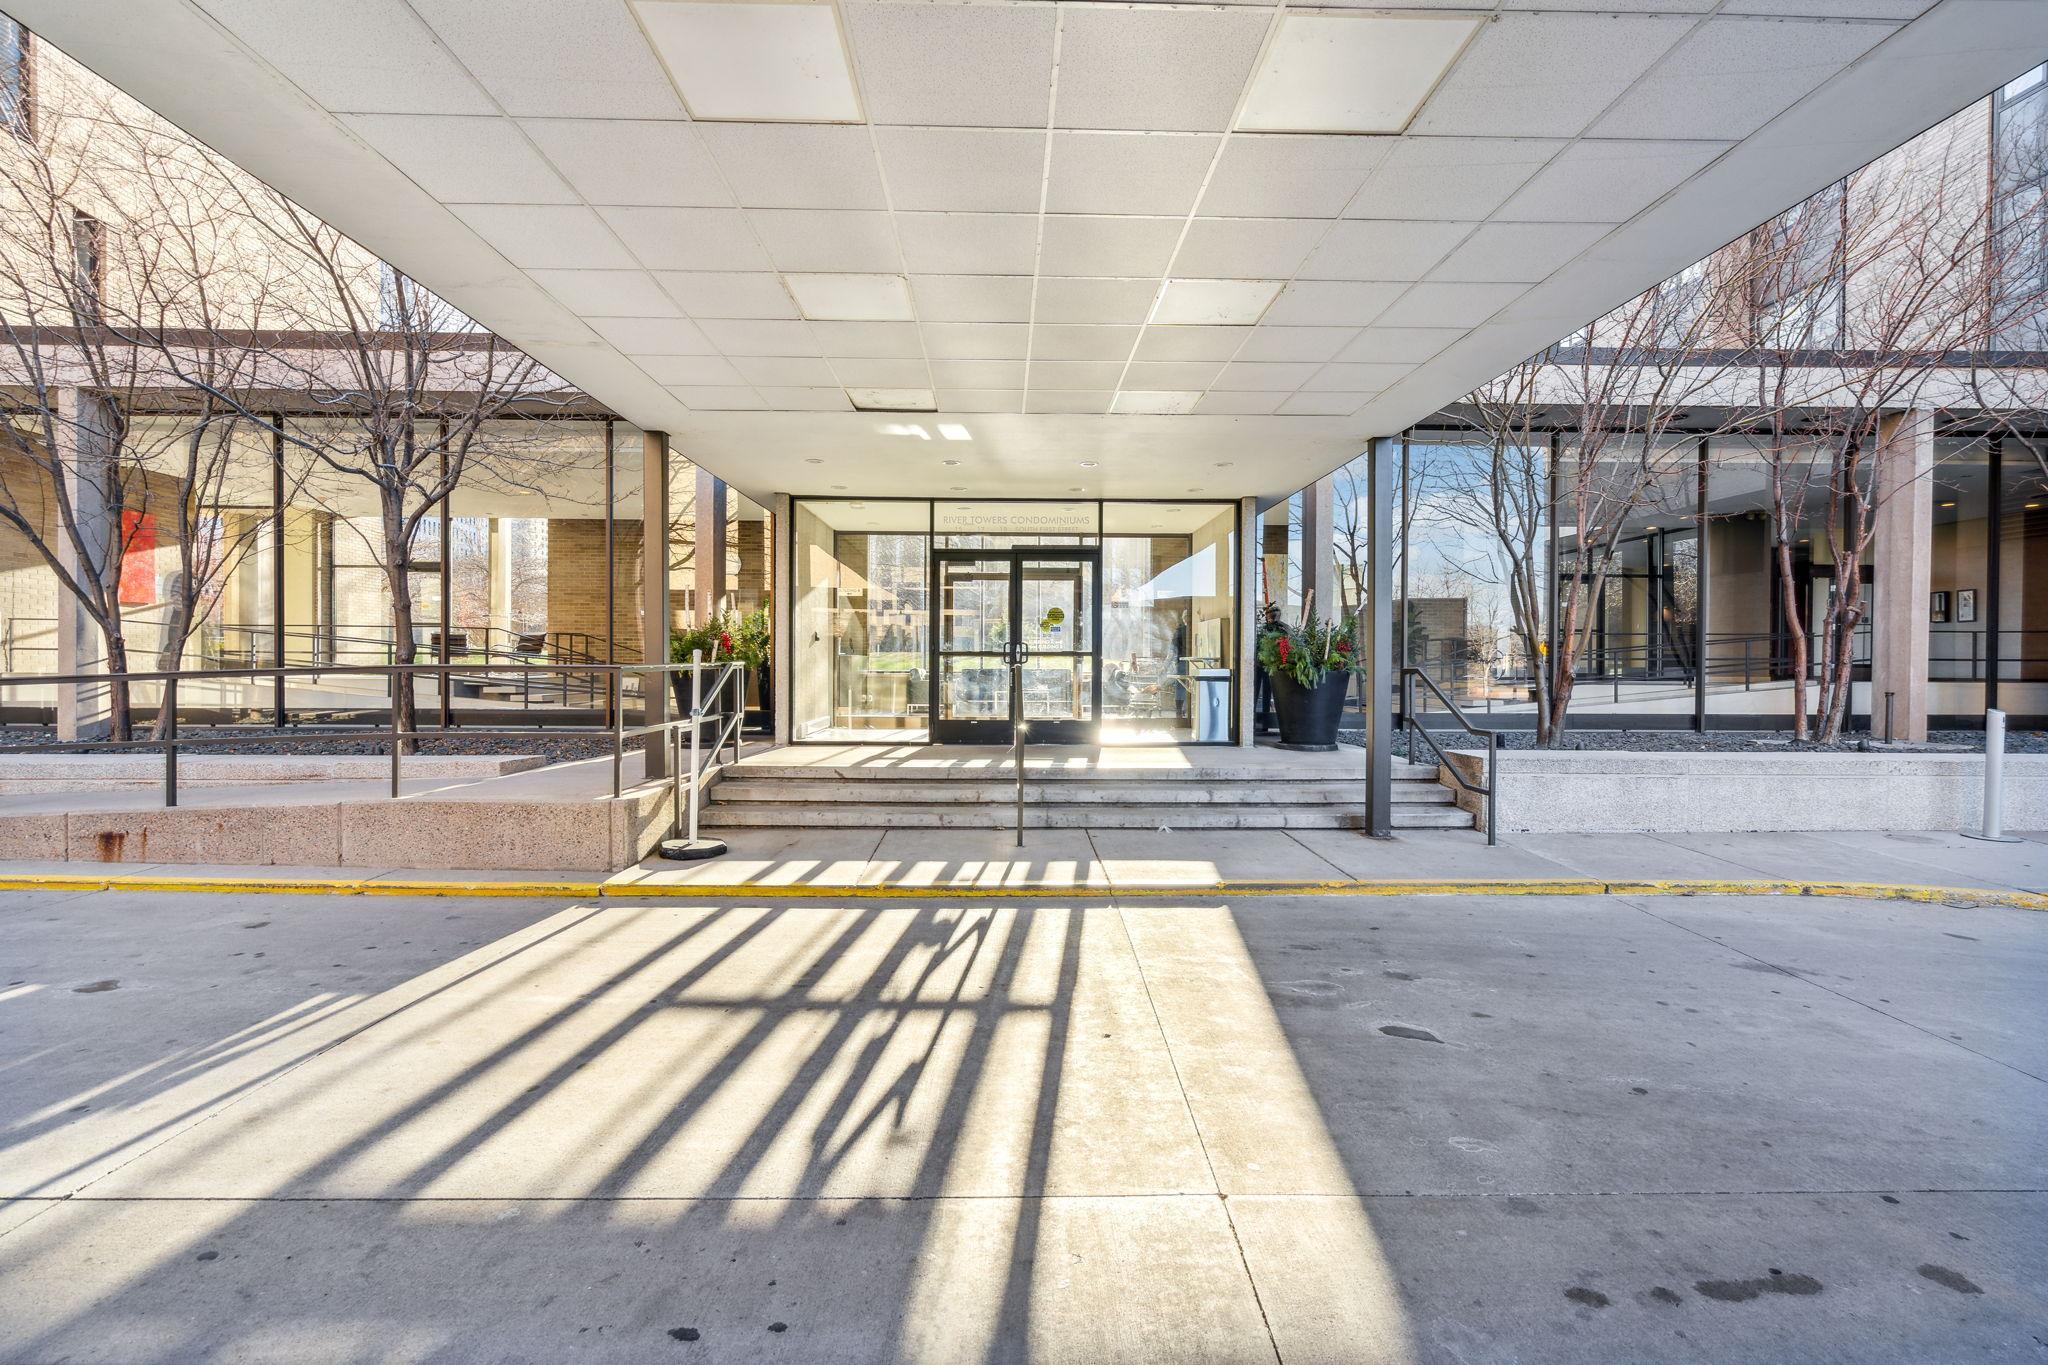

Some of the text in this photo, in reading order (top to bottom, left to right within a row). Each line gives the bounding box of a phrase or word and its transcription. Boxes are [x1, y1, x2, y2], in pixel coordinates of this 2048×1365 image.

[943, 516, 1090, 525] RIVER TOWERS CONDOMINIUMS
